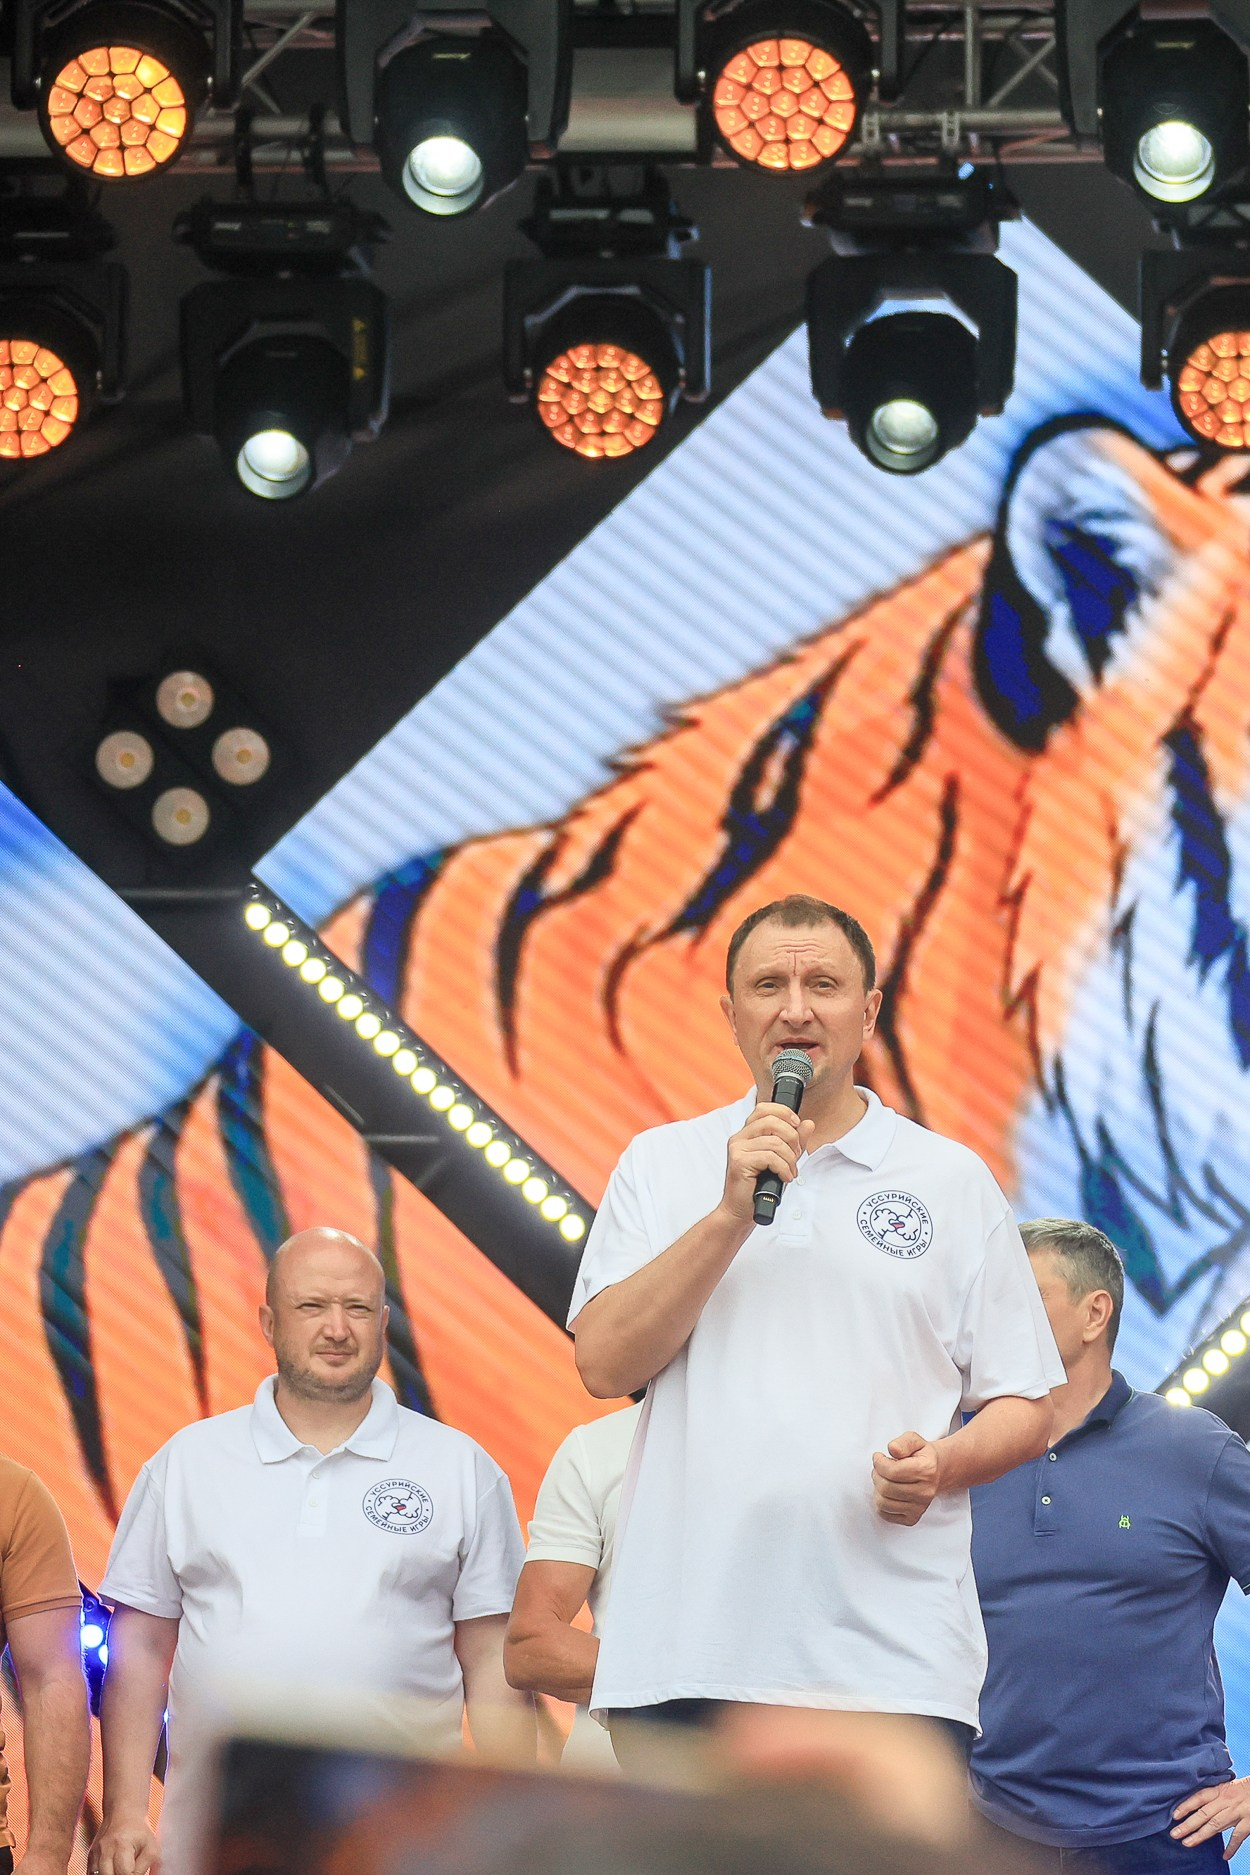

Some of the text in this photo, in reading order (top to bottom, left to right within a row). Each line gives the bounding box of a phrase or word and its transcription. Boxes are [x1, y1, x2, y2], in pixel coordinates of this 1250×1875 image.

[866, 1193, 929, 1224] УССУРИЙСКИЕ
[860, 1220, 927, 1256] СЕМЕЙНЫЕ ИГРЫ
[370, 1481, 429, 1503] УССУРИЙСКИЕ
[366, 1506, 429, 1532] СЕМЕЙНЫЕ ИГРЫ
